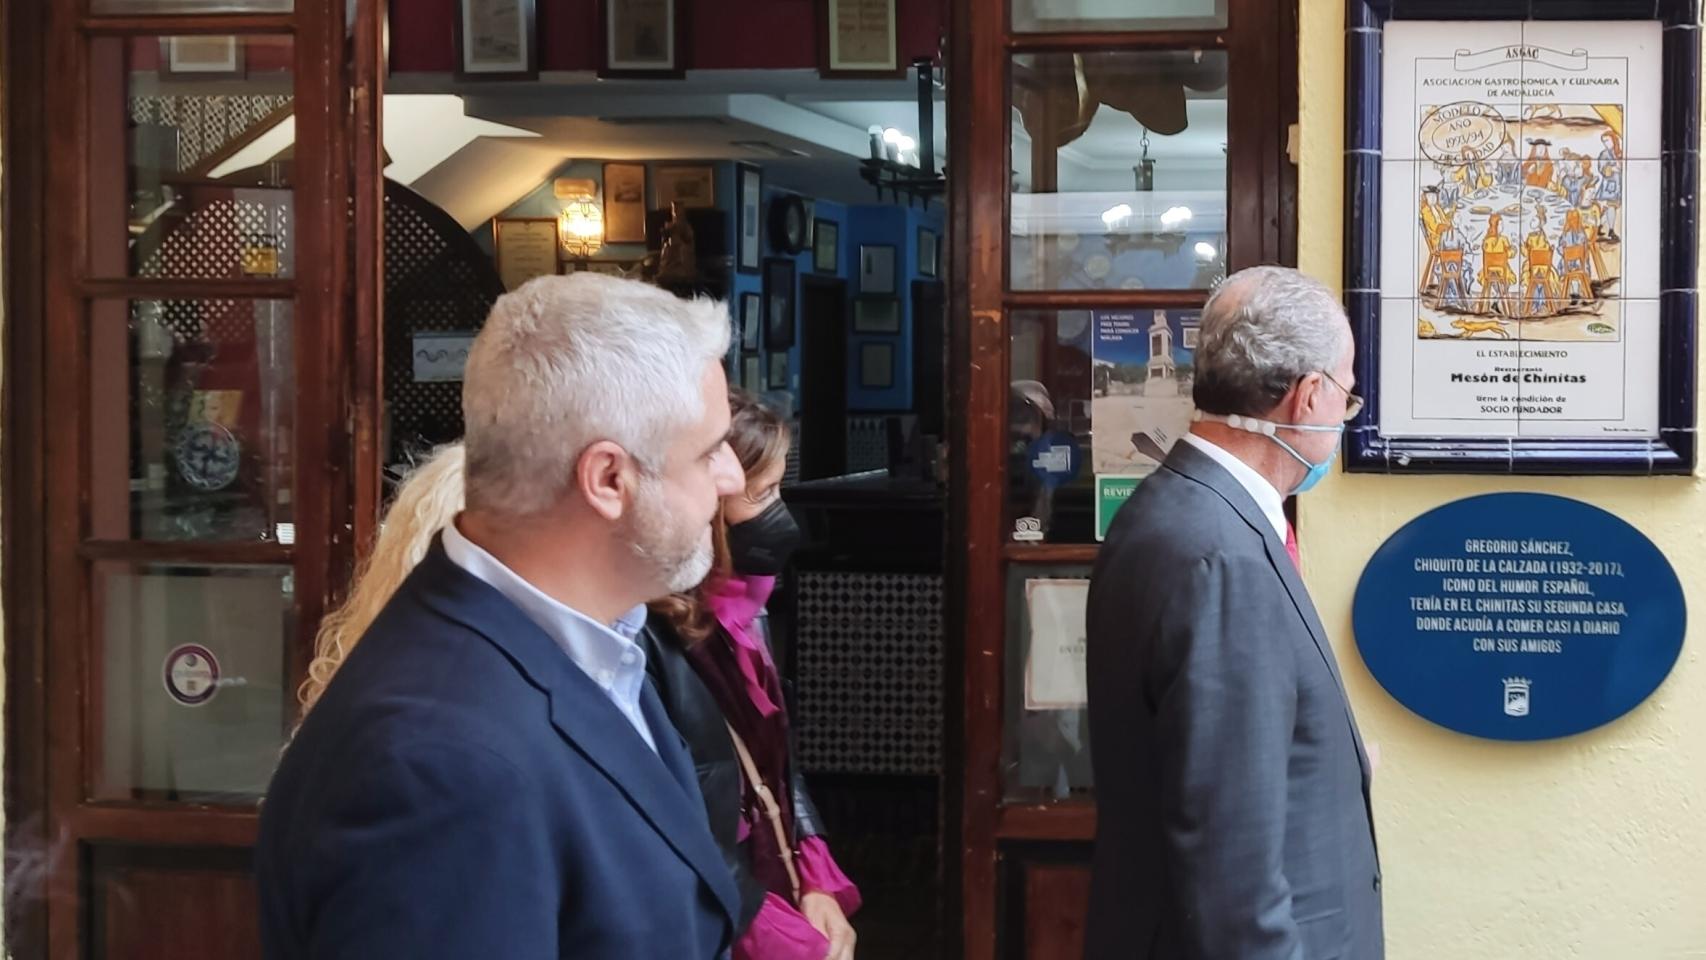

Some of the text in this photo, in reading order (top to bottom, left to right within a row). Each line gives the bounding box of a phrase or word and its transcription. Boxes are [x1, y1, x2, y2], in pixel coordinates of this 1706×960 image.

[1505, 48, 1539, 59] ASGAC
[1423, 78, 1619, 86] ASOCIACION GASTRONOMICA Y CULINARIA
[1487, 89, 1554, 97] DE ANDALUCIA
[1433, 106, 1481, 123] MODELO
[1448, 119, 1472, 131] AÑO
[1445, 129, 1484, 148] 1993/94
[1489, 350, 1568, 358] ESTABLECIMIENTO
[1451, 373, 1586, 383] Mesón de Chinitas
[1103, 487, 1135, 497] REVIE
[1465, 537, 1574, 556] GREGORIO SÁNCHEZ,
[1414, 558, 1465, 573] CHIQUITO
[1467, 559, 1481, 573] DE
[1483, 559, 1497, 573] LA
[1498, 559, 1548, 574] CALZADA
[1443, 576, 1595, 596] ICONO DEL HUMOR ESPAÑOL,
[1410, 595, 1628, 617] TENÍA EN EL CHINITAS SU SEGUNDA CASA,
[1417, 615, 1620, 635] DONDE ACUDÍA A COMER CASI A DIARIO
[1473, 638, 1562, 654] CON SUS AMIGOS
